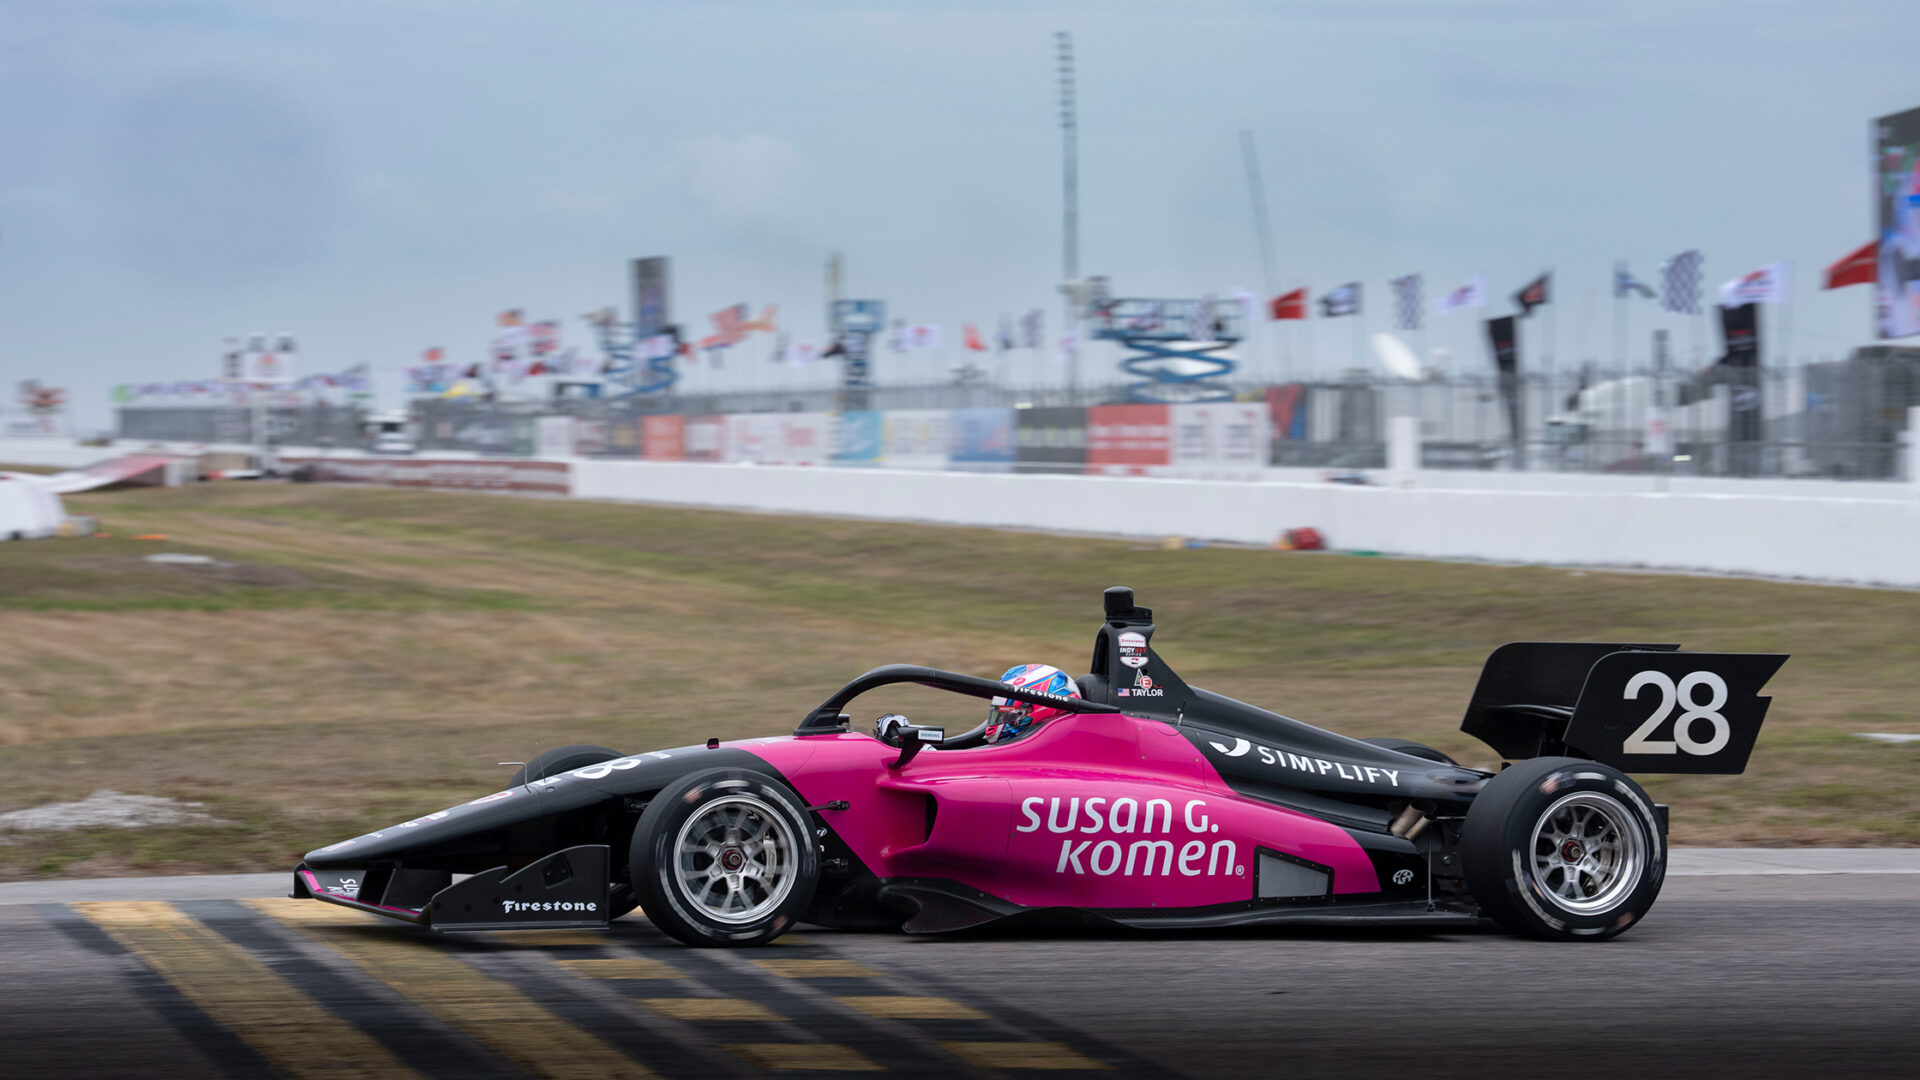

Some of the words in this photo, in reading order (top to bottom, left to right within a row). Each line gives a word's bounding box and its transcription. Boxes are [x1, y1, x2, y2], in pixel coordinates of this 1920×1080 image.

[1013, 685, 1069, 702] Firestone
[1131, 688, 1164, 697] TAYLOR
[1623, 670, 1731, 756] 28
[1257, 746, 1399, 787] SIMPLIFY
[502, 900, 597, 914] Firestone
